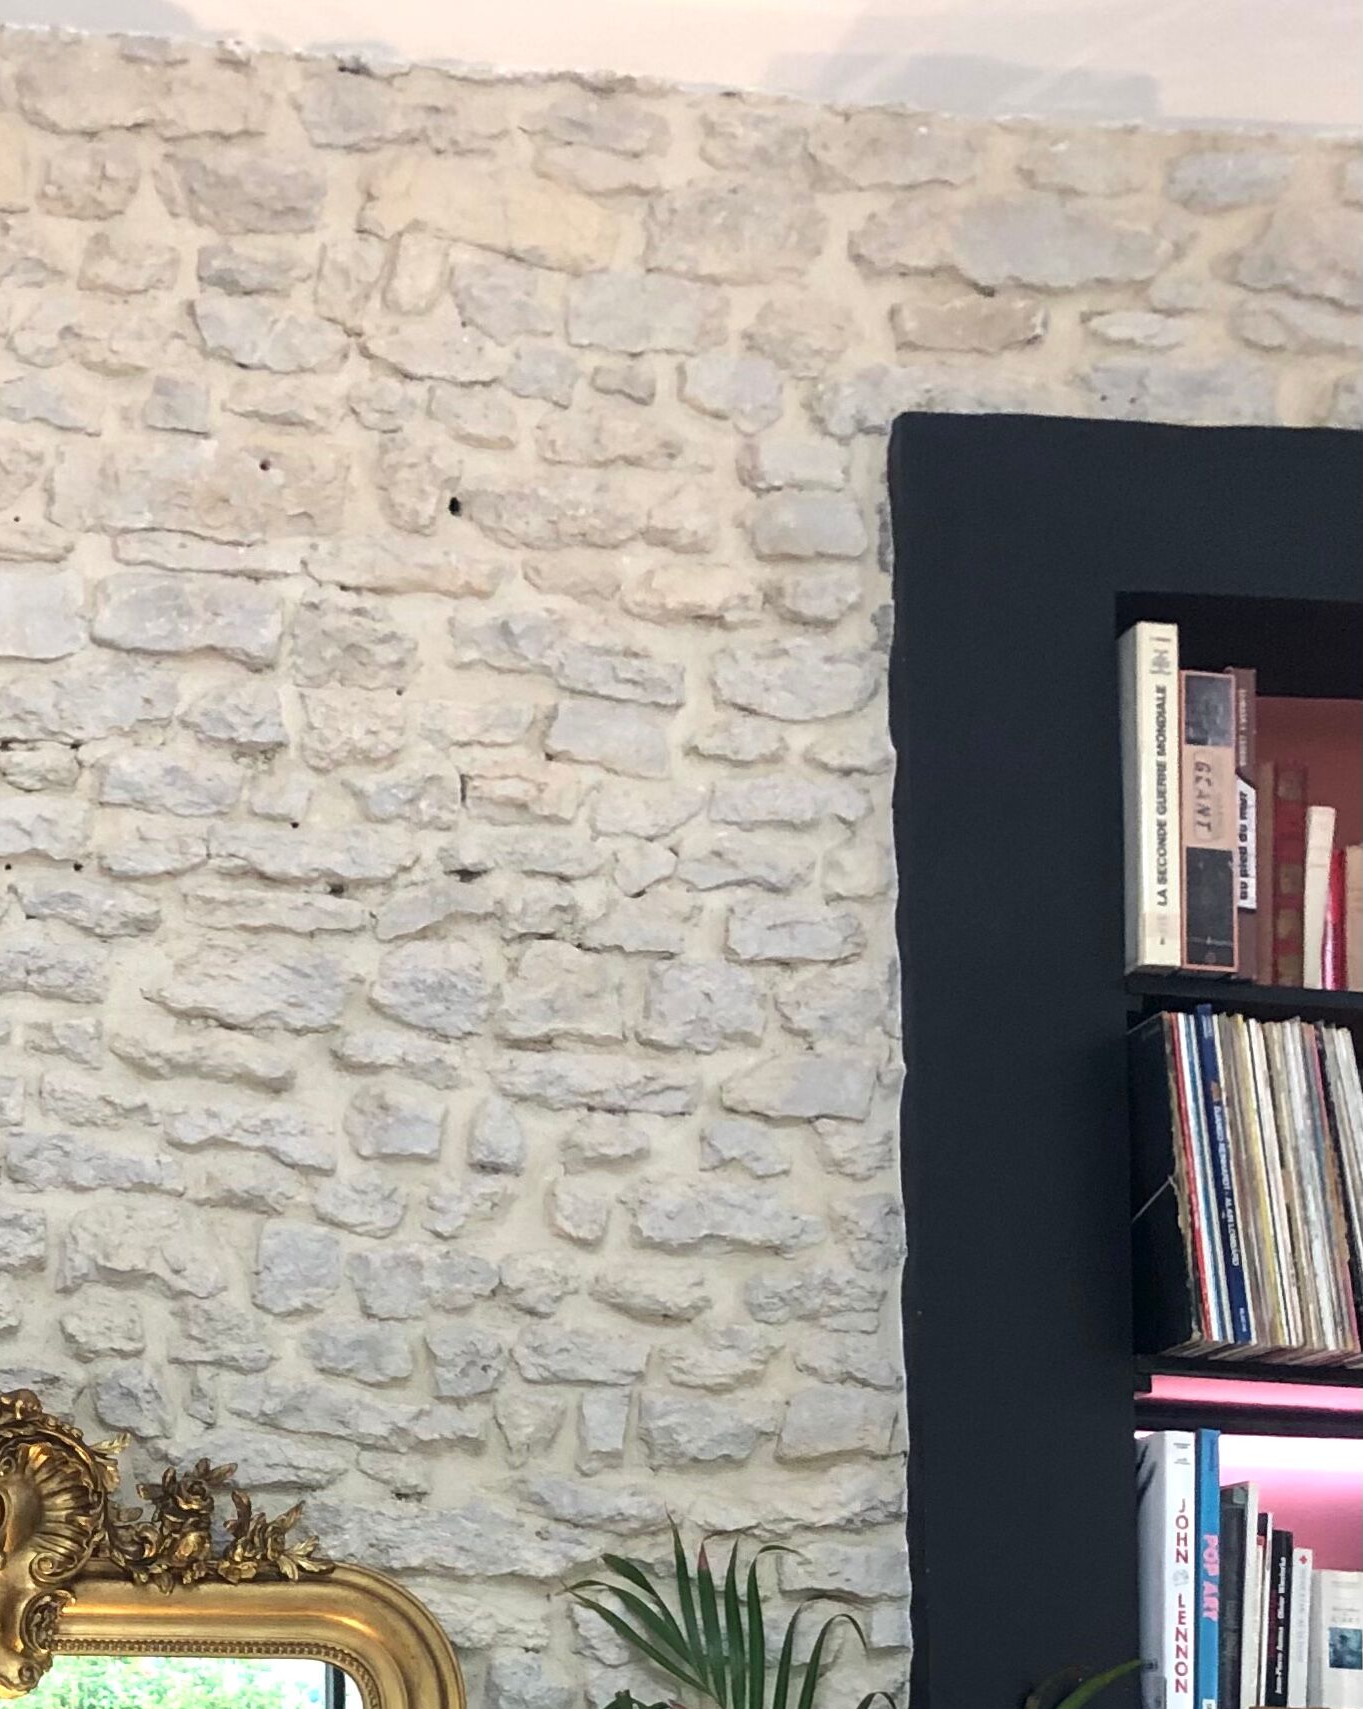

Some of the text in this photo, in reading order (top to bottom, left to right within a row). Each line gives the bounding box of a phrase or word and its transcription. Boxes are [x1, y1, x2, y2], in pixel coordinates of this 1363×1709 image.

[1156, 685, 1168, 757] MONDIALE
[1156, 760, 1168, 816] GUERRE
[1237, 791, 1248, 821] mur
[1156, 819, 1168, 886] SECONDE
[1238, 824, 1249, 842] du
[1238, 846, 1250, 878] pied
[1155, 888, 1168, 907] LA
[1174, 1498, 1190, 1695] JOHN LENNON
[1202, 1534, 1219, 1622] POP ART
